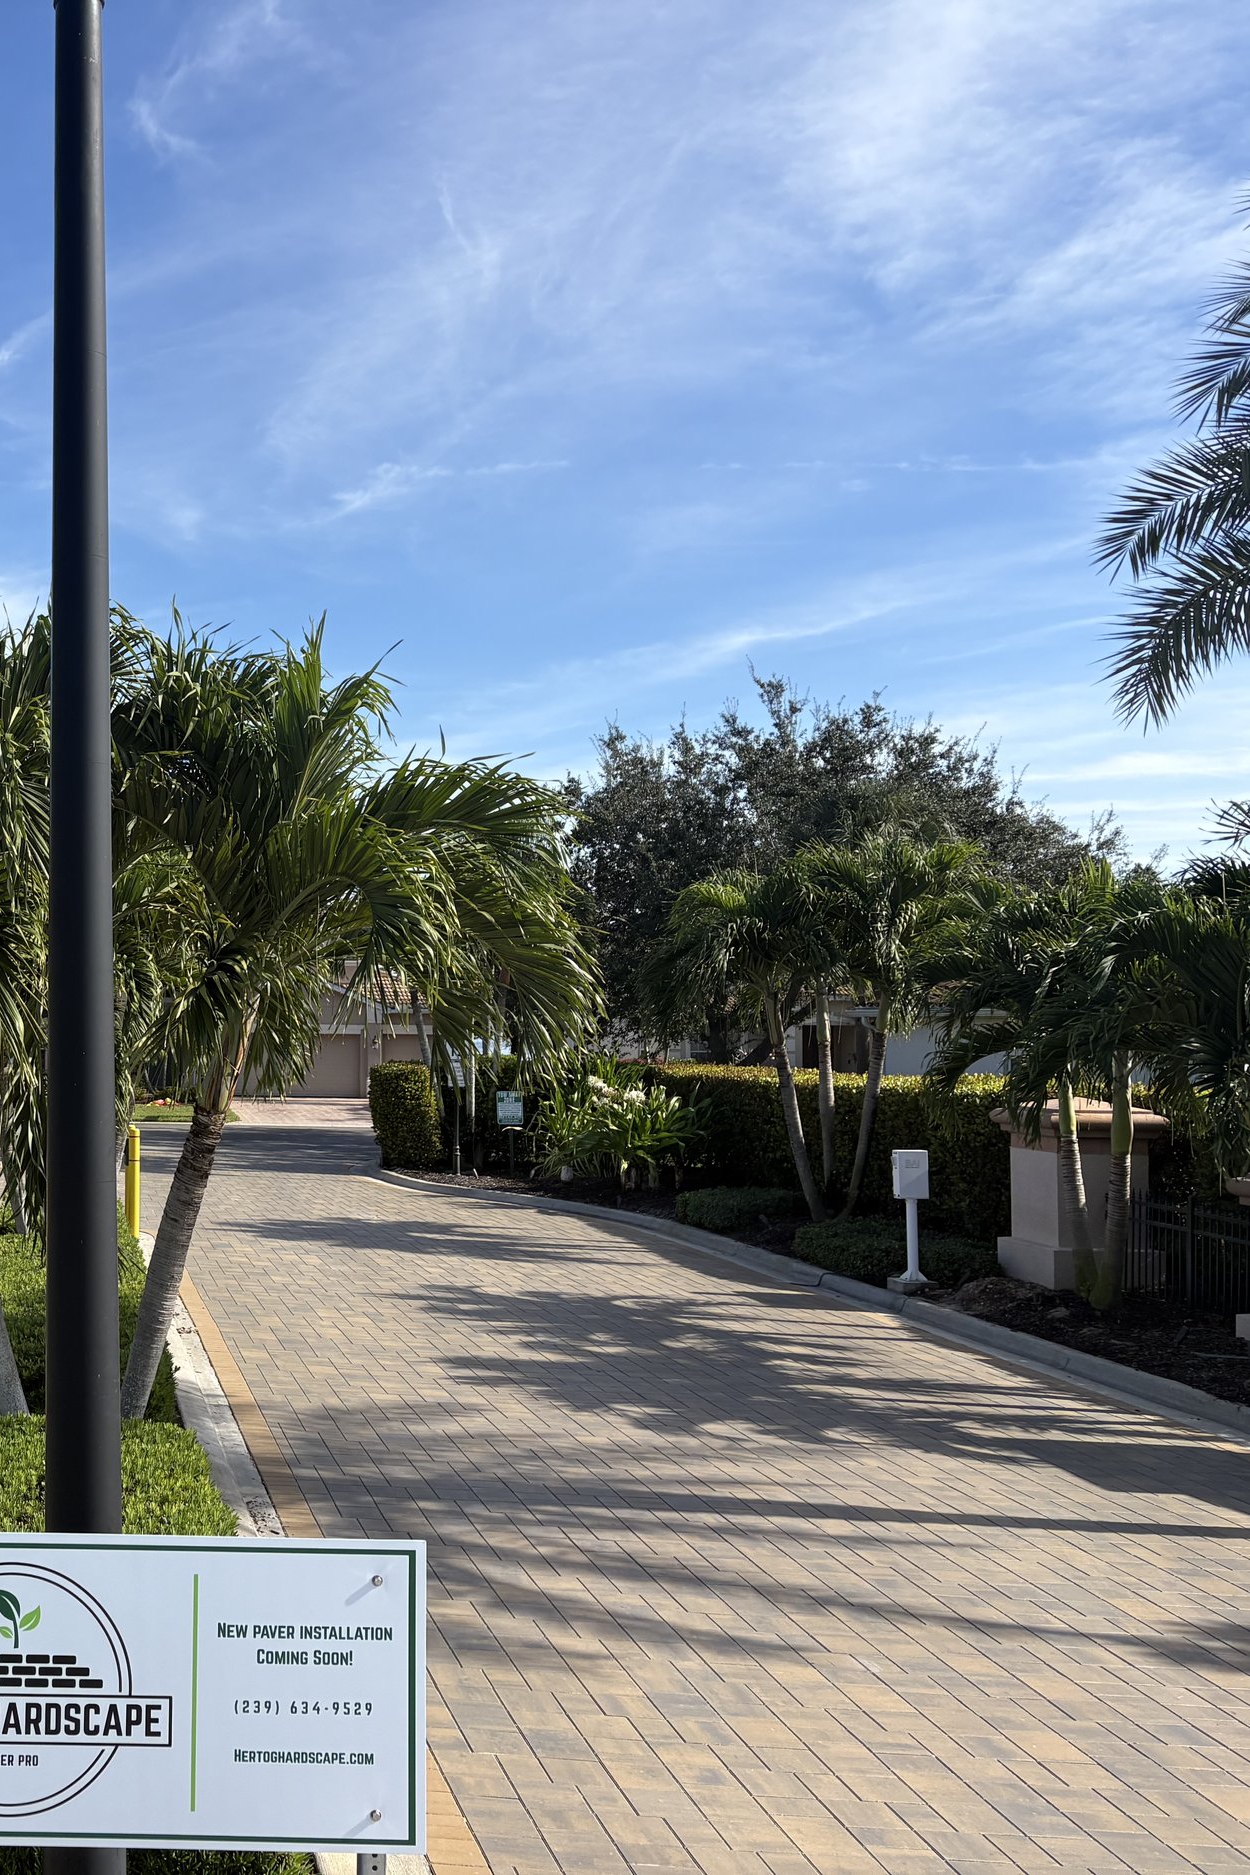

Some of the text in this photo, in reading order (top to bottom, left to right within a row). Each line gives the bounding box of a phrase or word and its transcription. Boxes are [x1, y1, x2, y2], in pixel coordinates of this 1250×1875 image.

[217, 1622, 393, 1641] NEW PAVER INSTALLATION
[256, 1648, 354, 1666] COMING SOON!
[234, 1699, 373, 1716] (239) 634-9529
[17, 1754, 39, 1767] PRO
